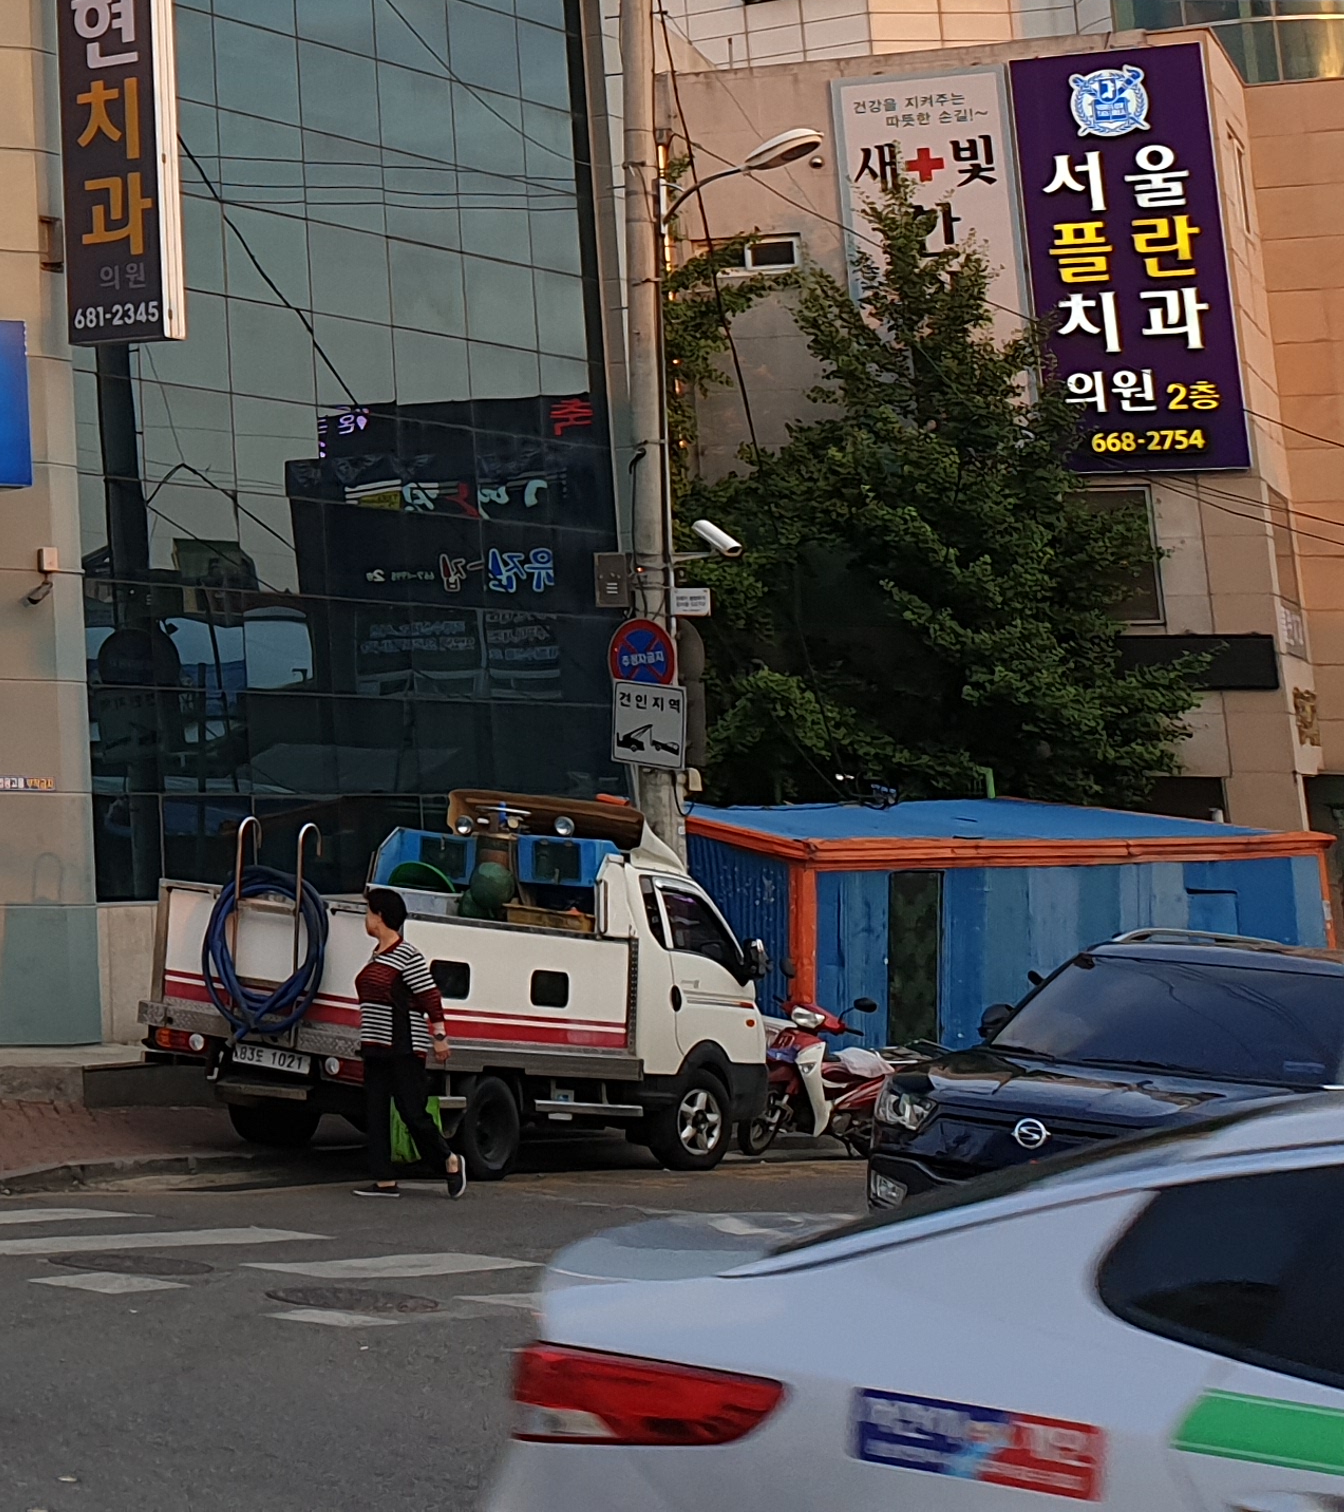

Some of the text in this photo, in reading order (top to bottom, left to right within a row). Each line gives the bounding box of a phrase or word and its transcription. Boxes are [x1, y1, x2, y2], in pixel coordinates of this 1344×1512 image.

[853, 92, 965, 115] 건강을 지켜주는
[885, 110, 930, 127] 따뜻한
[74, 301, 159, 329] 681-2345
[1065, 369, 1220, 413] 의원 2층
[1092, 429, 1205, 454] 668-2754
[619, 692, 680, 714] 견인지역
[272, 1052, 303, 1069] 1021
